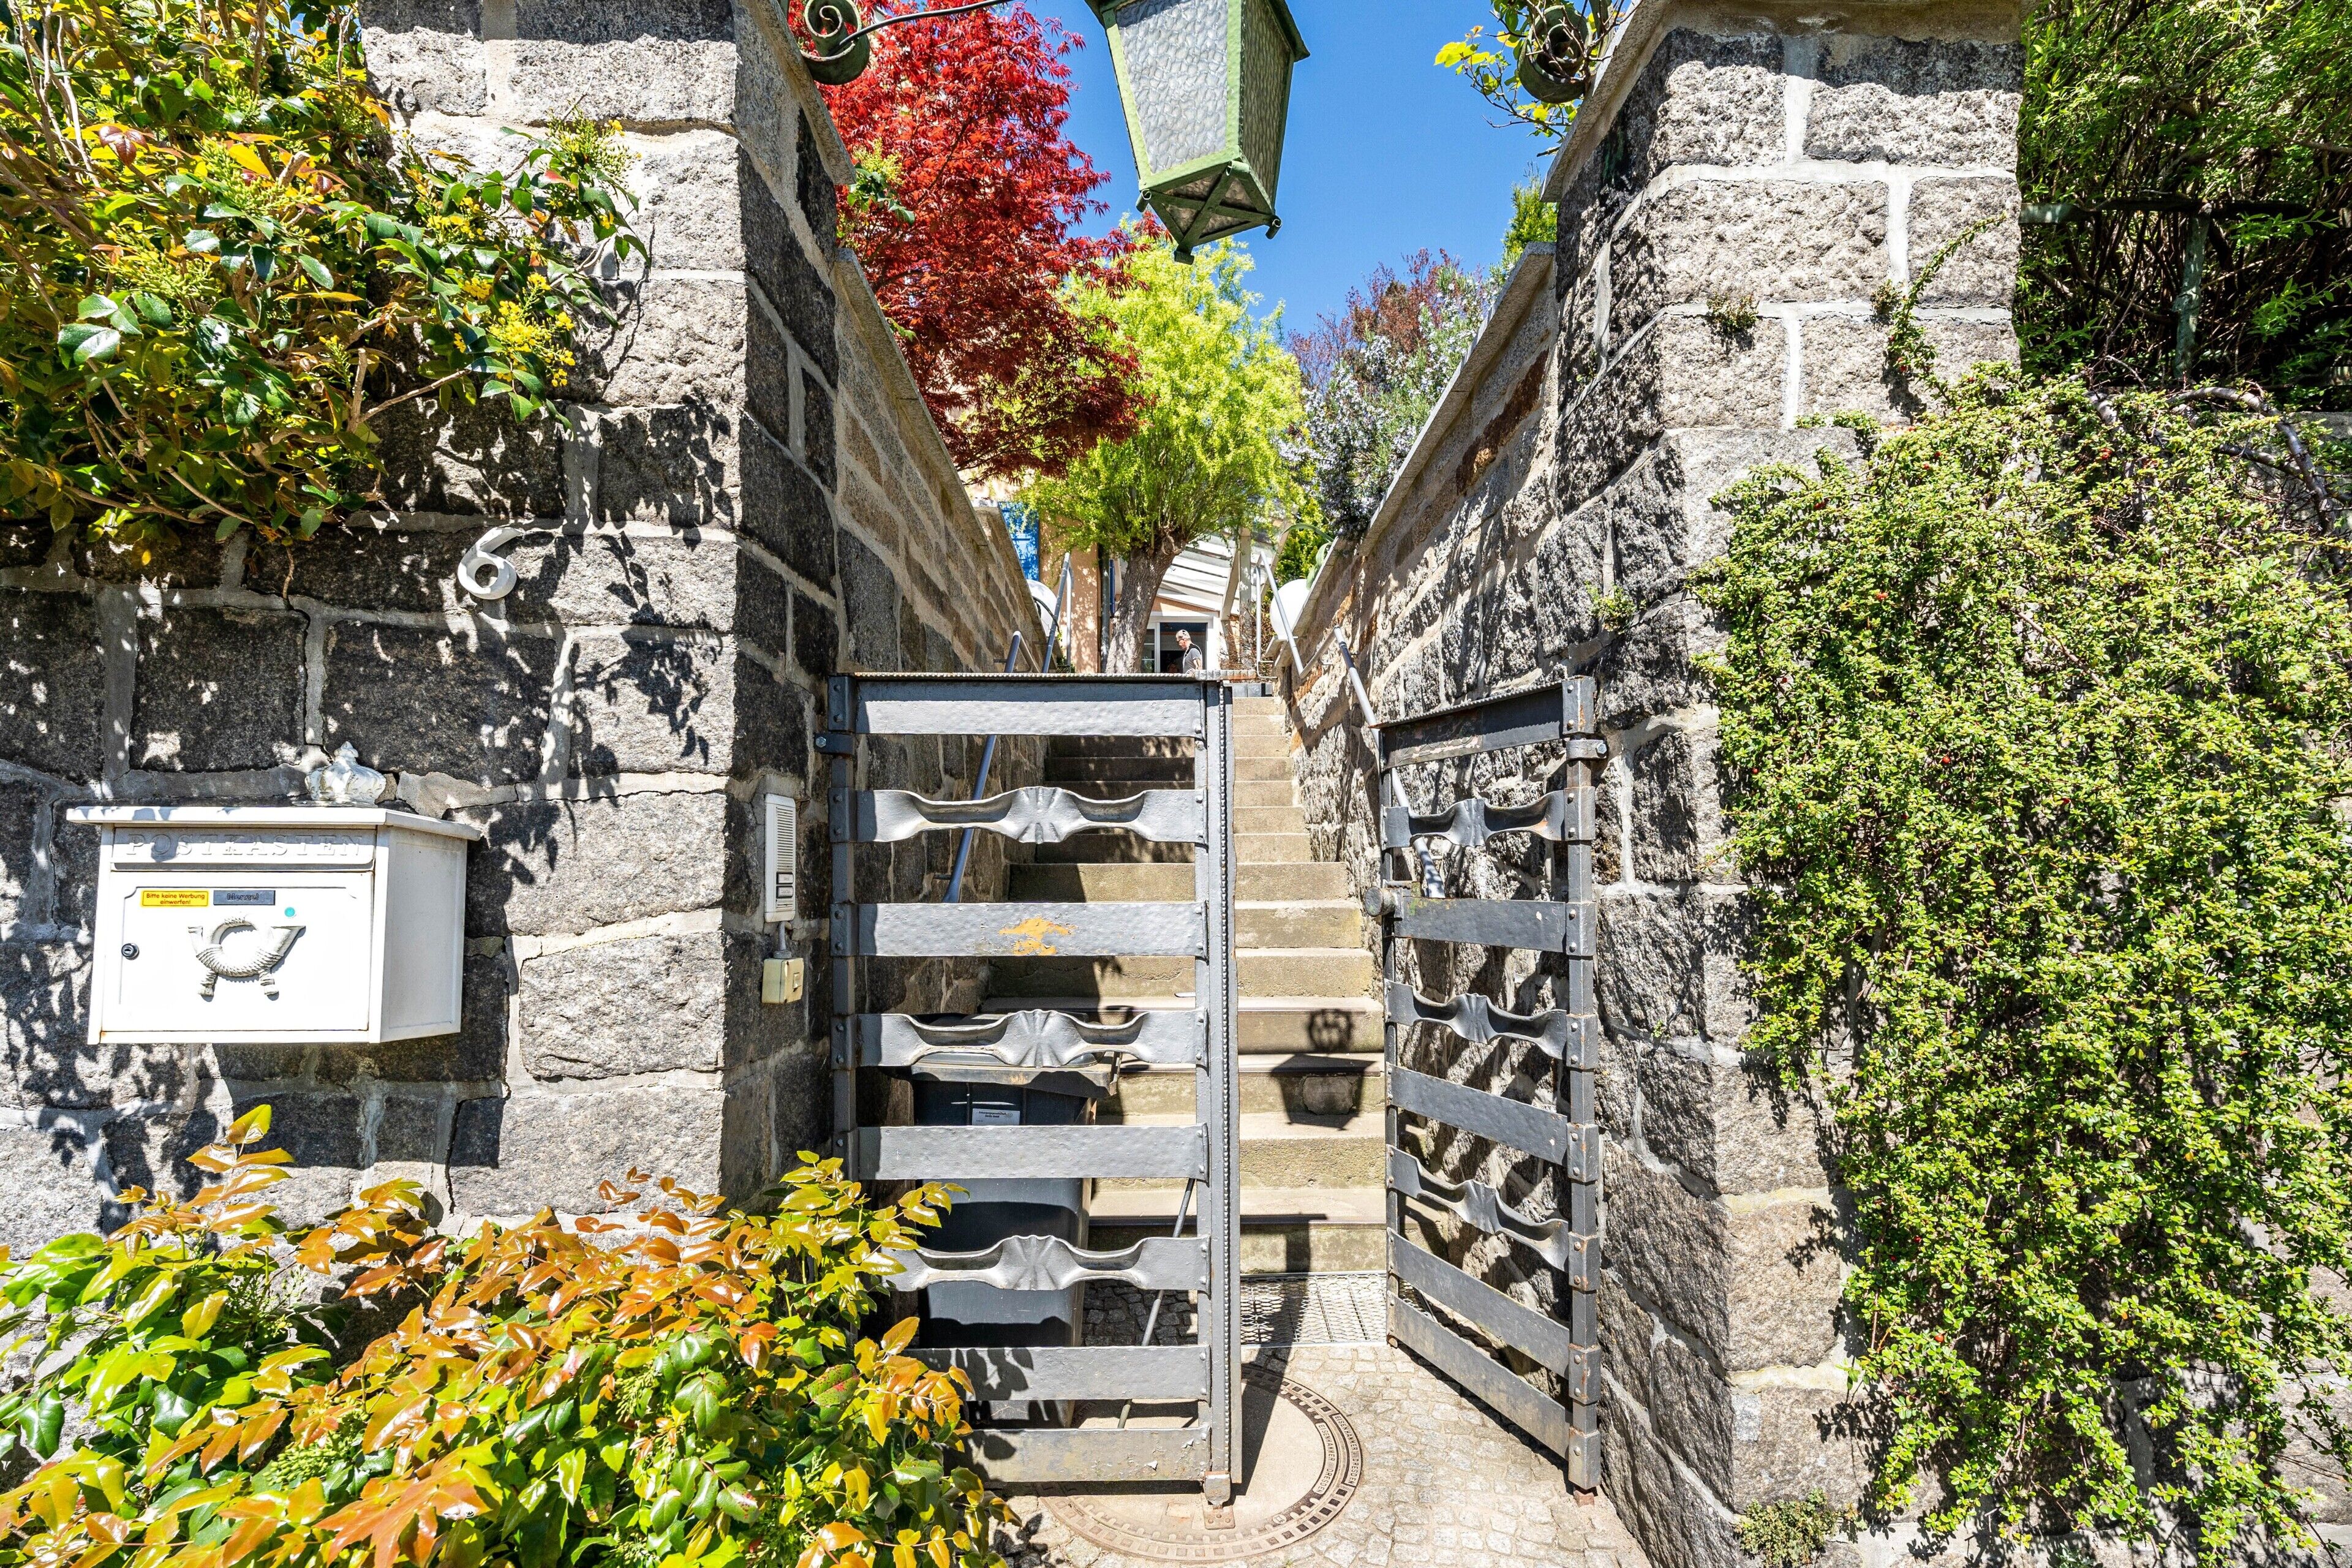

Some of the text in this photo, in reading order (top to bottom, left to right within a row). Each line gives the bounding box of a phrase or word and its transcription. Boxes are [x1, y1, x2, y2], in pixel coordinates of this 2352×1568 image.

[458, 527, 522, 600] 6
[126, 834, 363, 856] POSTKASTEN
[1317, 1424, 1336, 1495] EISENHAMMER DRESDEN
[1335, 1415, 1359, 1485] EISENHAMMER DRESDEN
